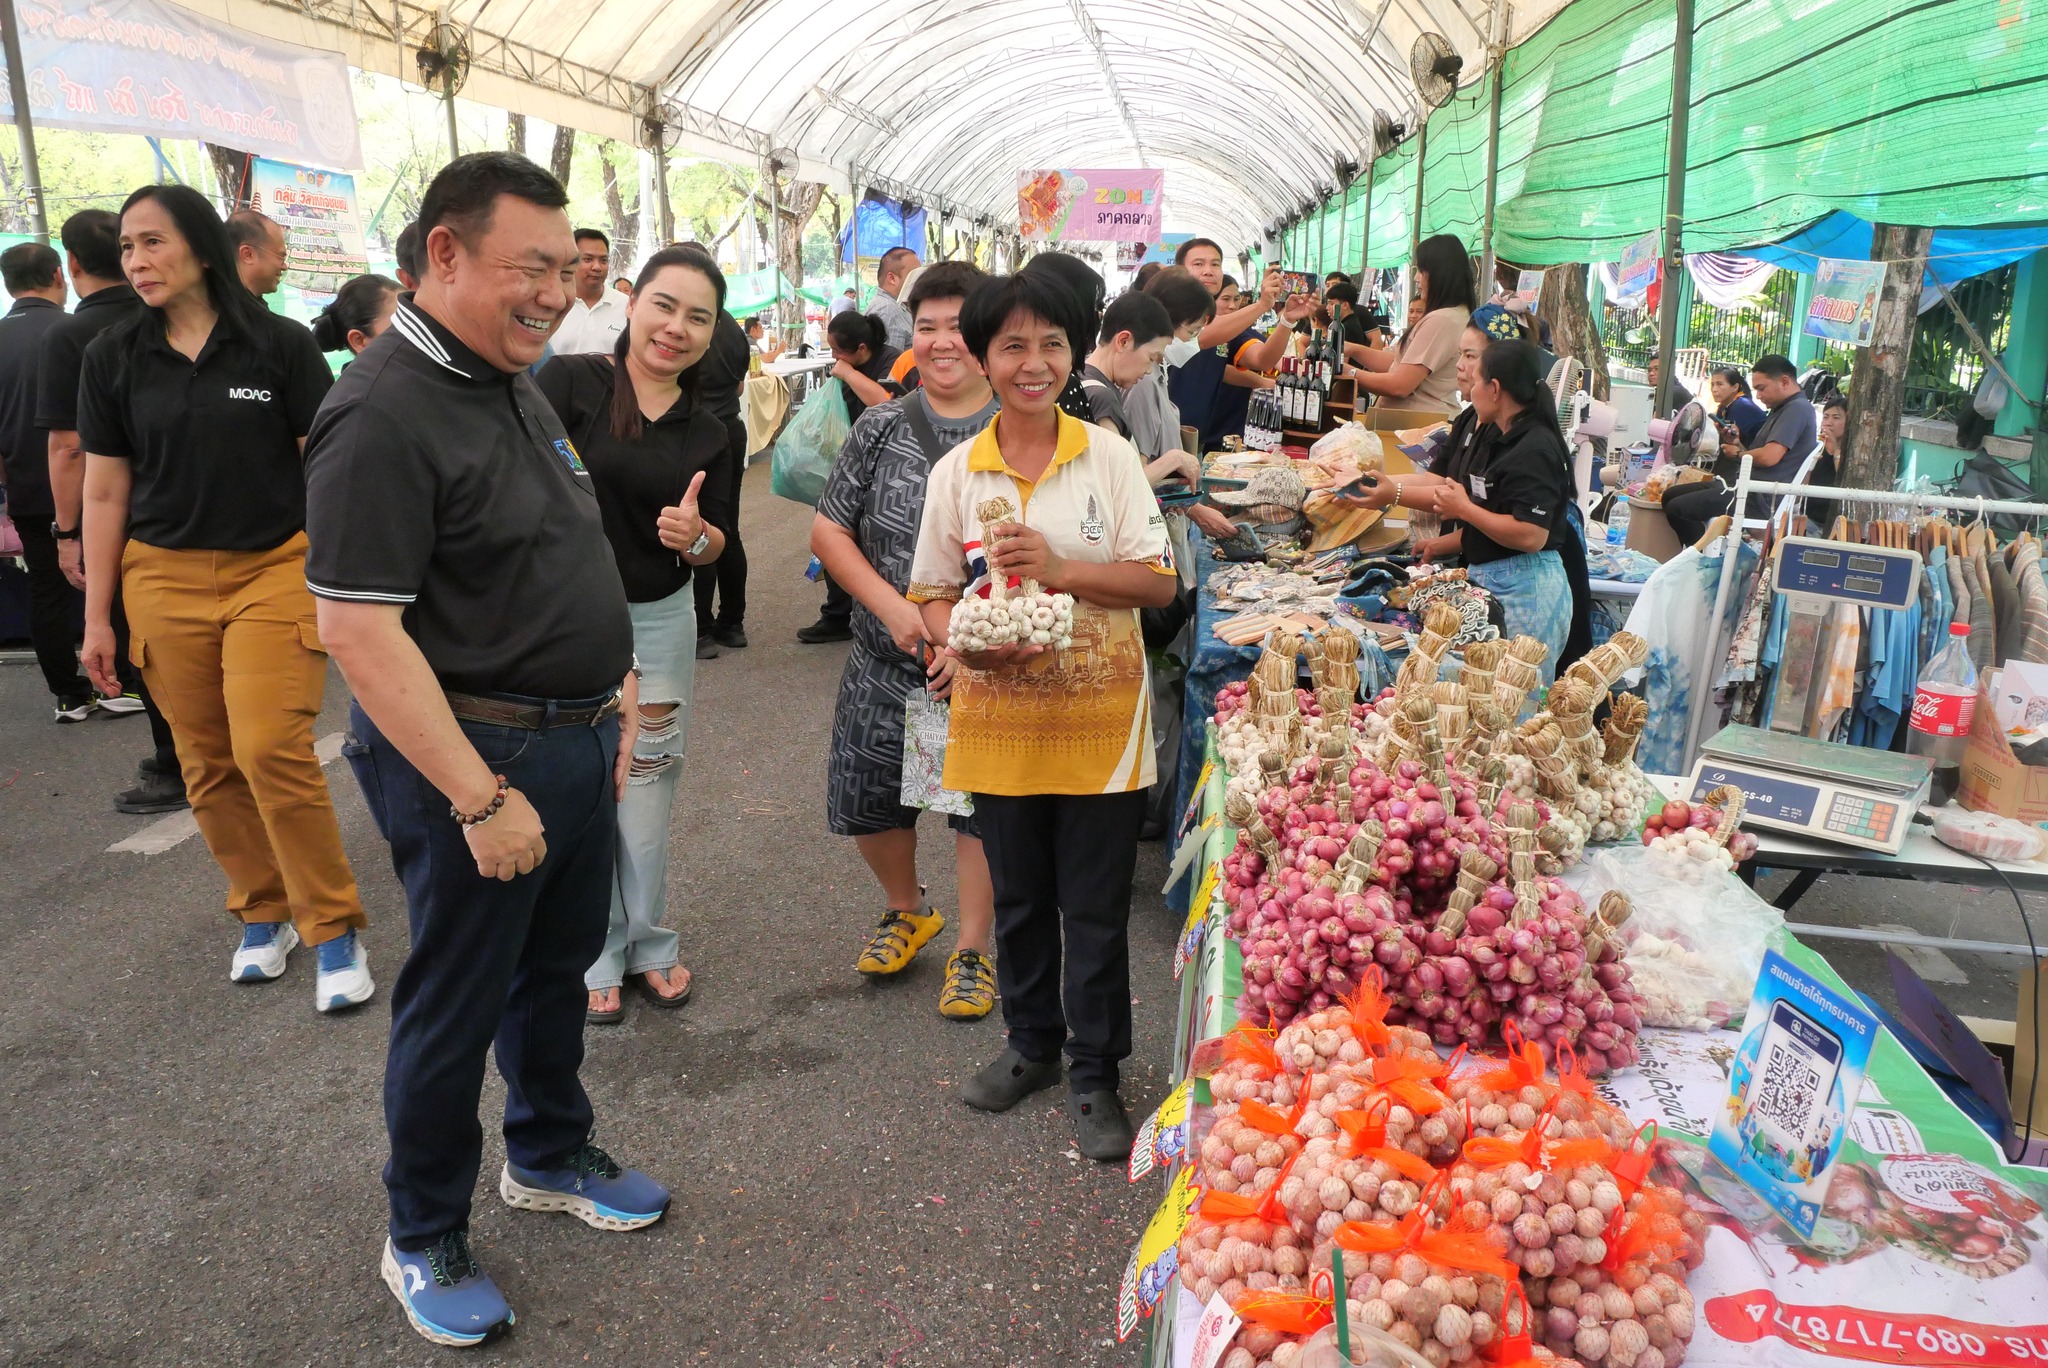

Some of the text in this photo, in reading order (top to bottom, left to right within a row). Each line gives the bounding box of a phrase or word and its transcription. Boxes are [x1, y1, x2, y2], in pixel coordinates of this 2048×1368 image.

[1094, 188, 1156, 205] ZONE
[1097, 212, 1153, 226] ภาคกลาง
[229, 388, 272, 402] MOAC
[1770, 964, 1866, 1035] สแกนจ่ายได้ทุกธนาคาร
